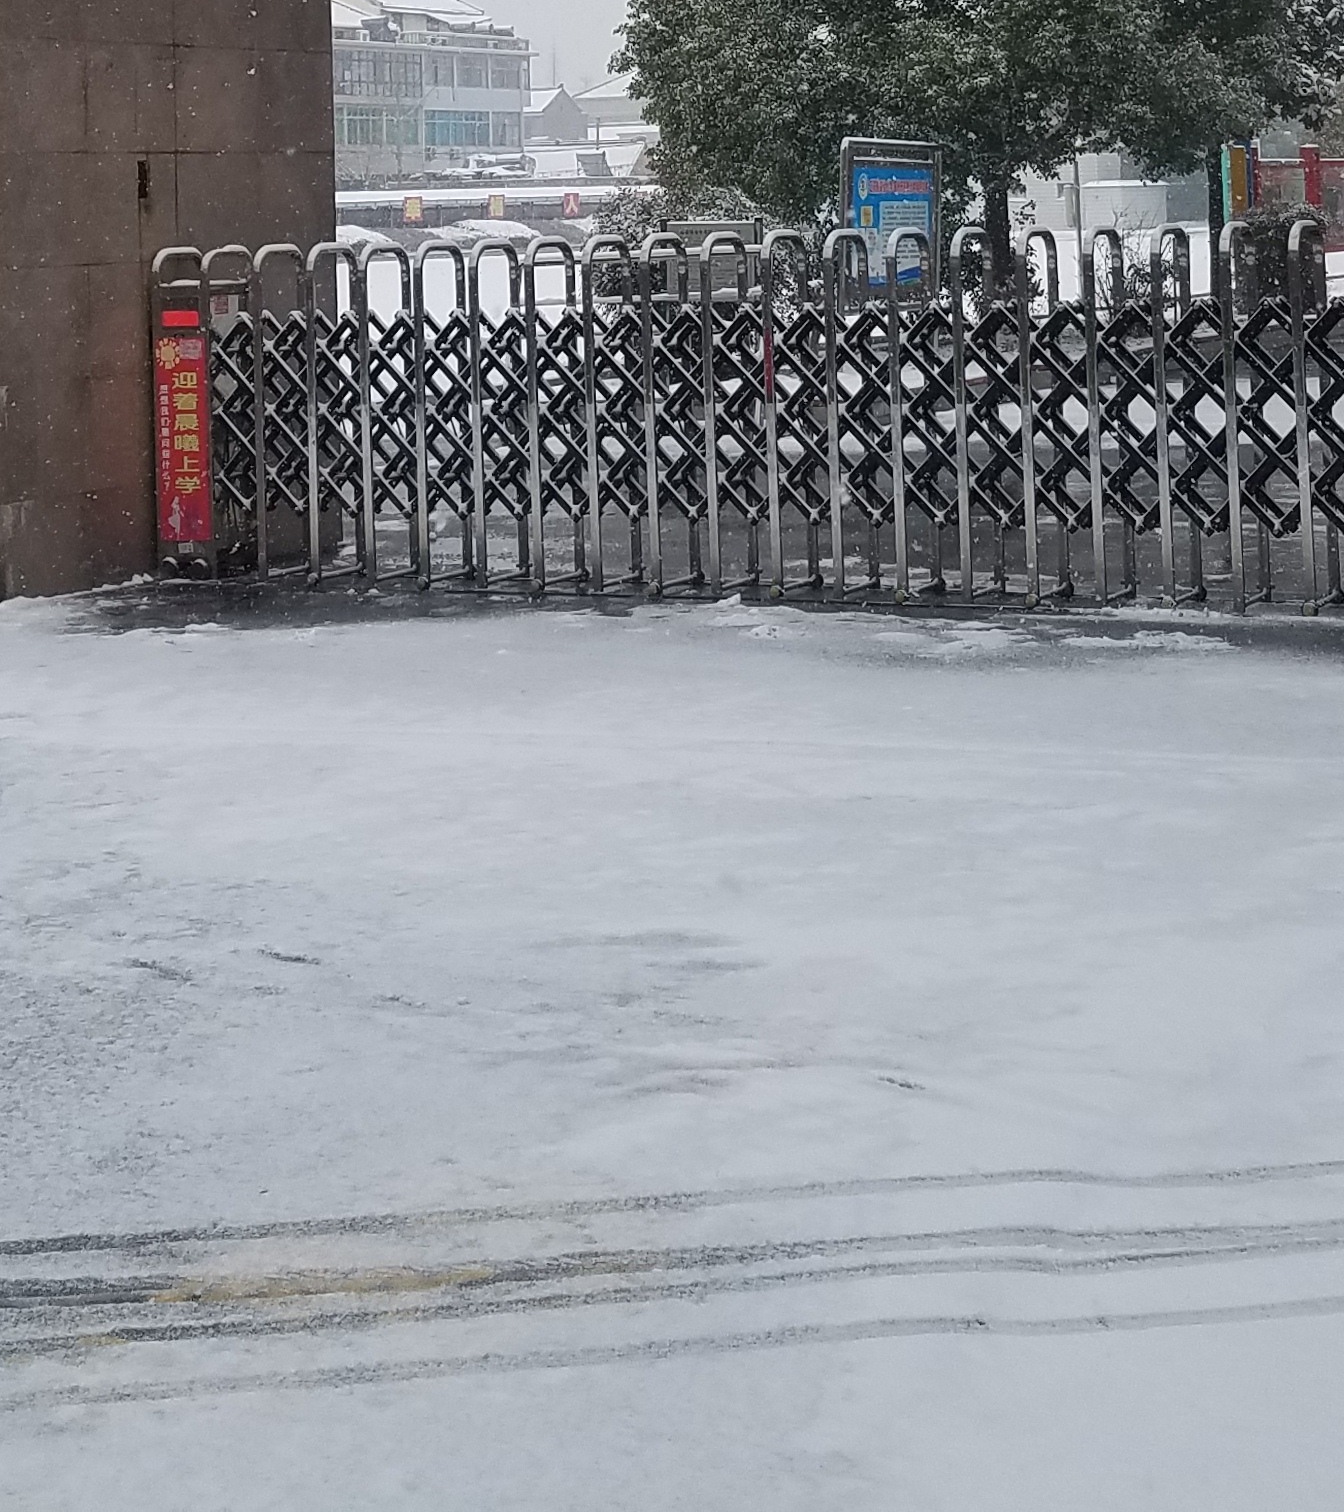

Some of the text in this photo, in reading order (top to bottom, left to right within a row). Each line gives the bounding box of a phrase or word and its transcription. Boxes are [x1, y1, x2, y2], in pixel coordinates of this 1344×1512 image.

[171, 371, 202, 494] 迎着晨曦上学
